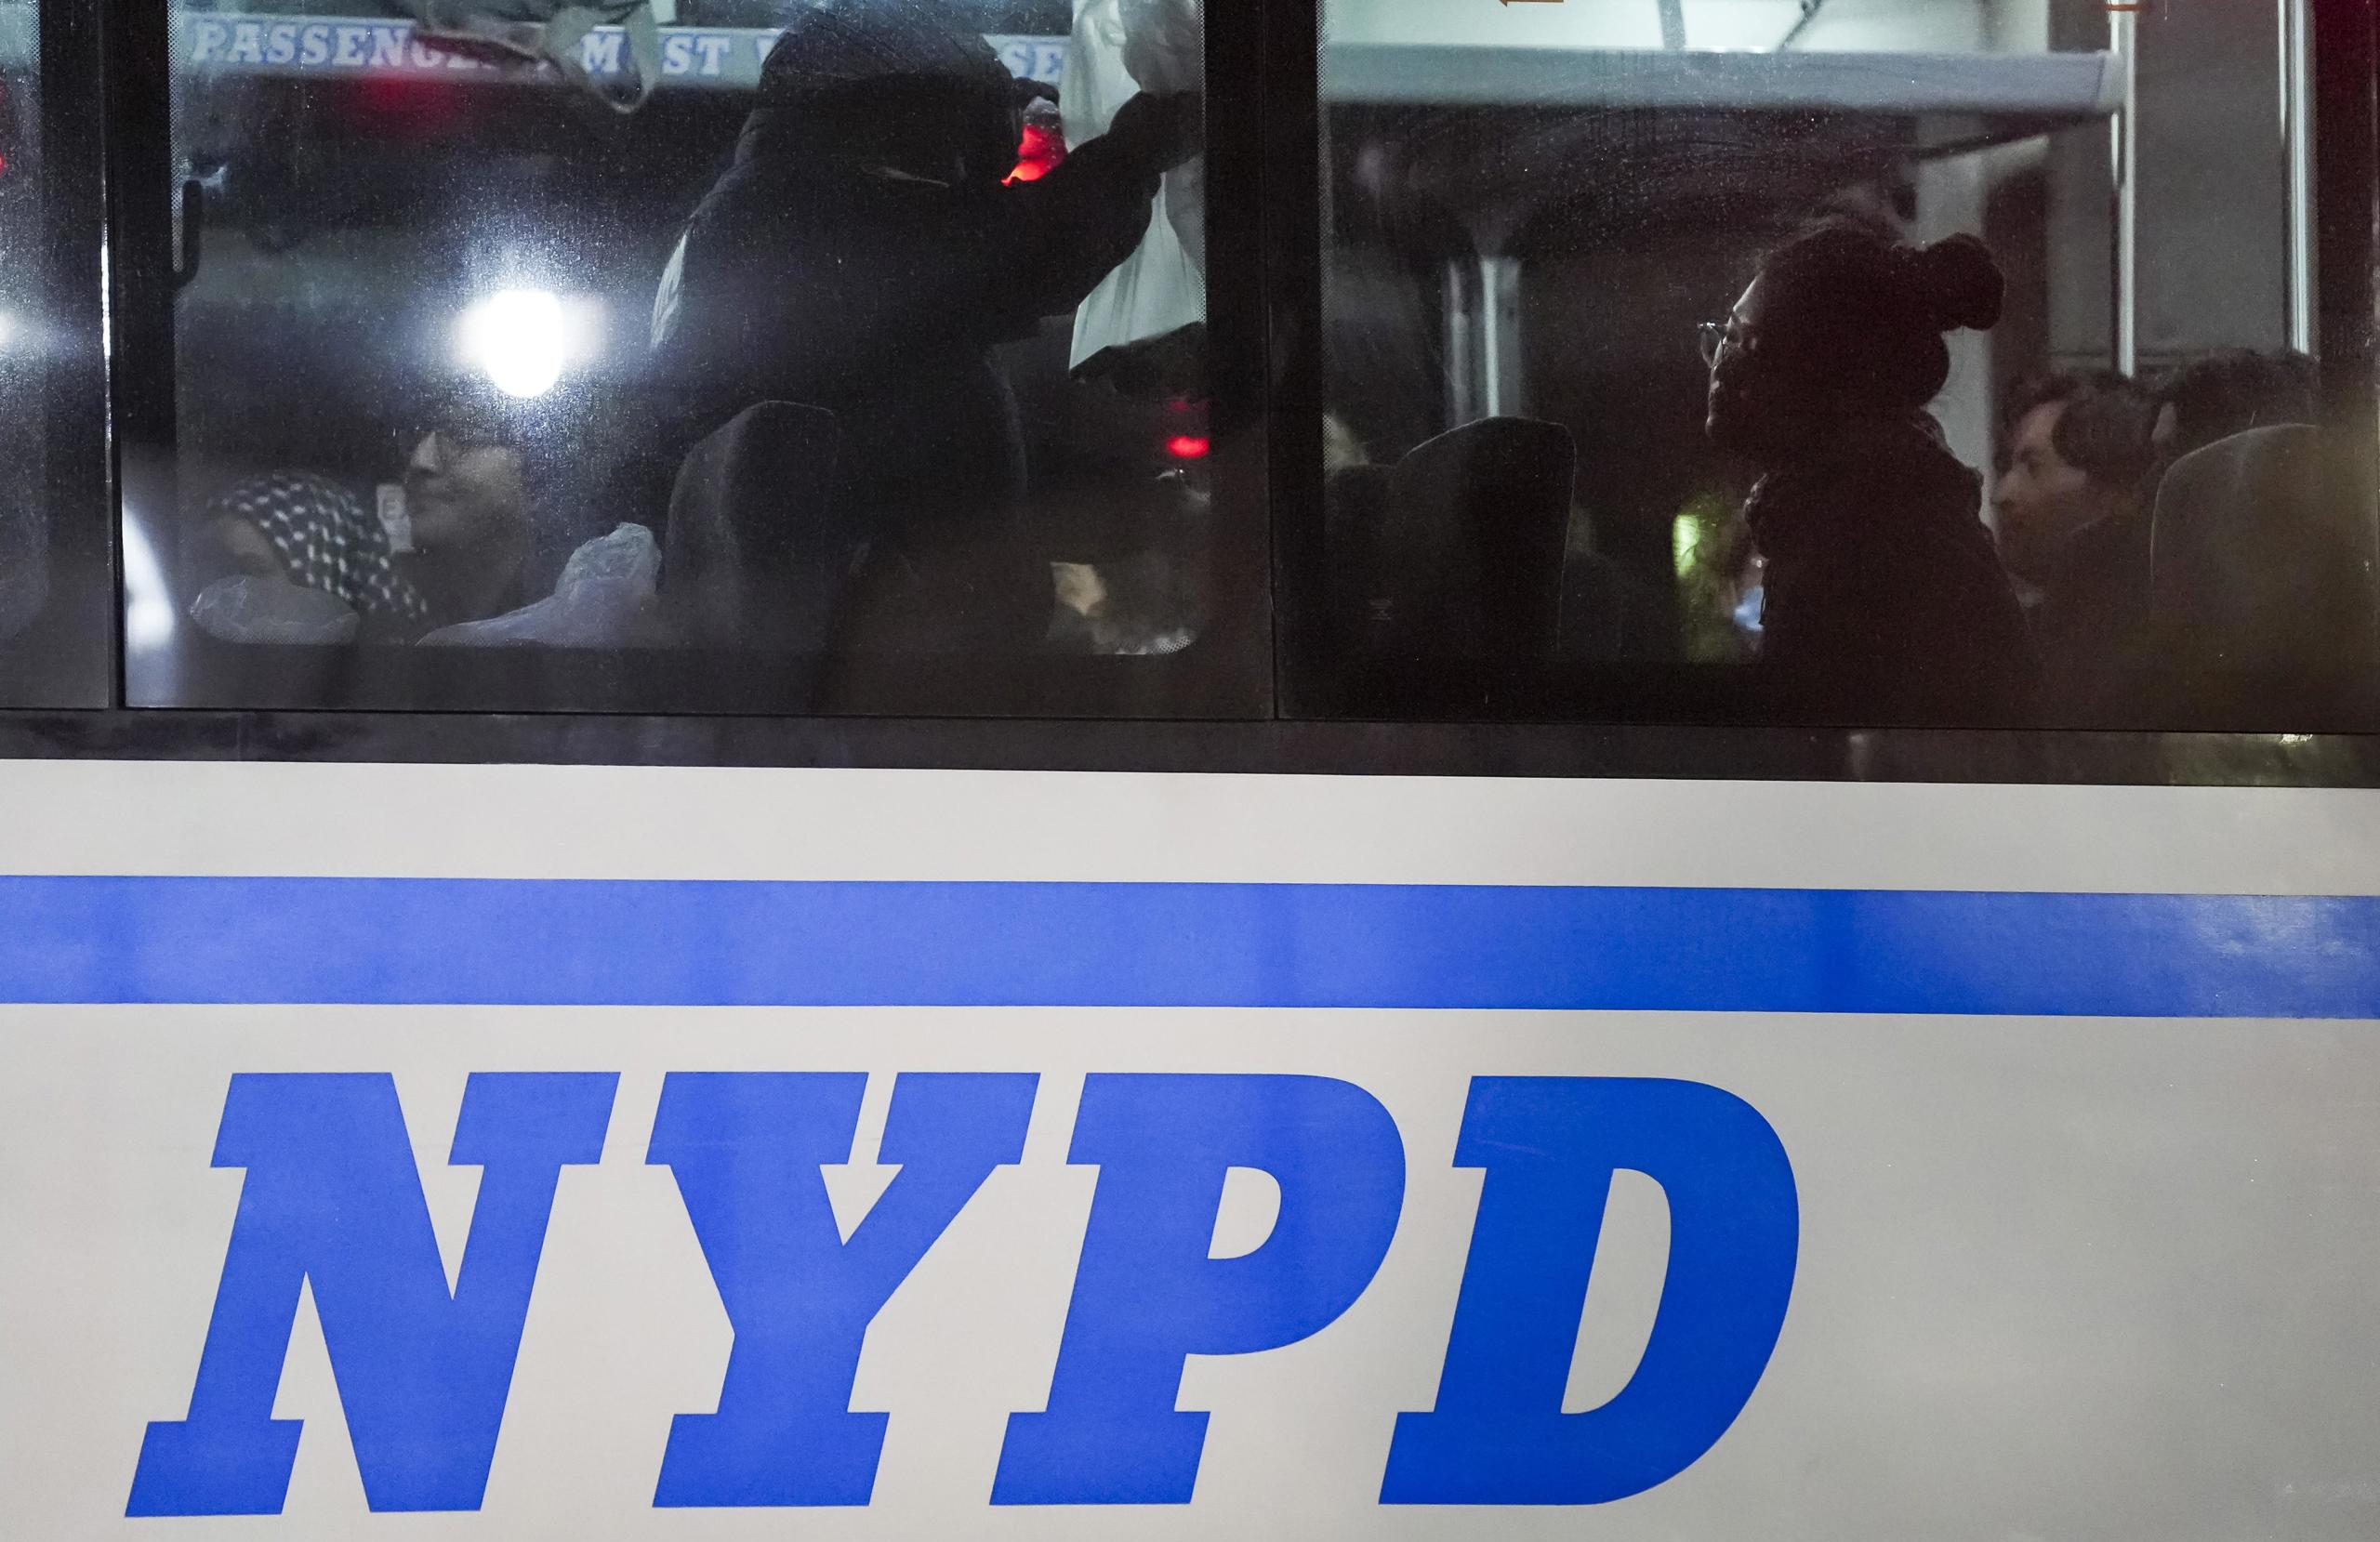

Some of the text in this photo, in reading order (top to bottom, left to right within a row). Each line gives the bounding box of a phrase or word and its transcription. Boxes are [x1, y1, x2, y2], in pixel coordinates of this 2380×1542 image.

[192, 21, 552, 69] PASSENG
[580, 33, 731, 75] MST
[126, 1072, 1799, 1517] NYPD
